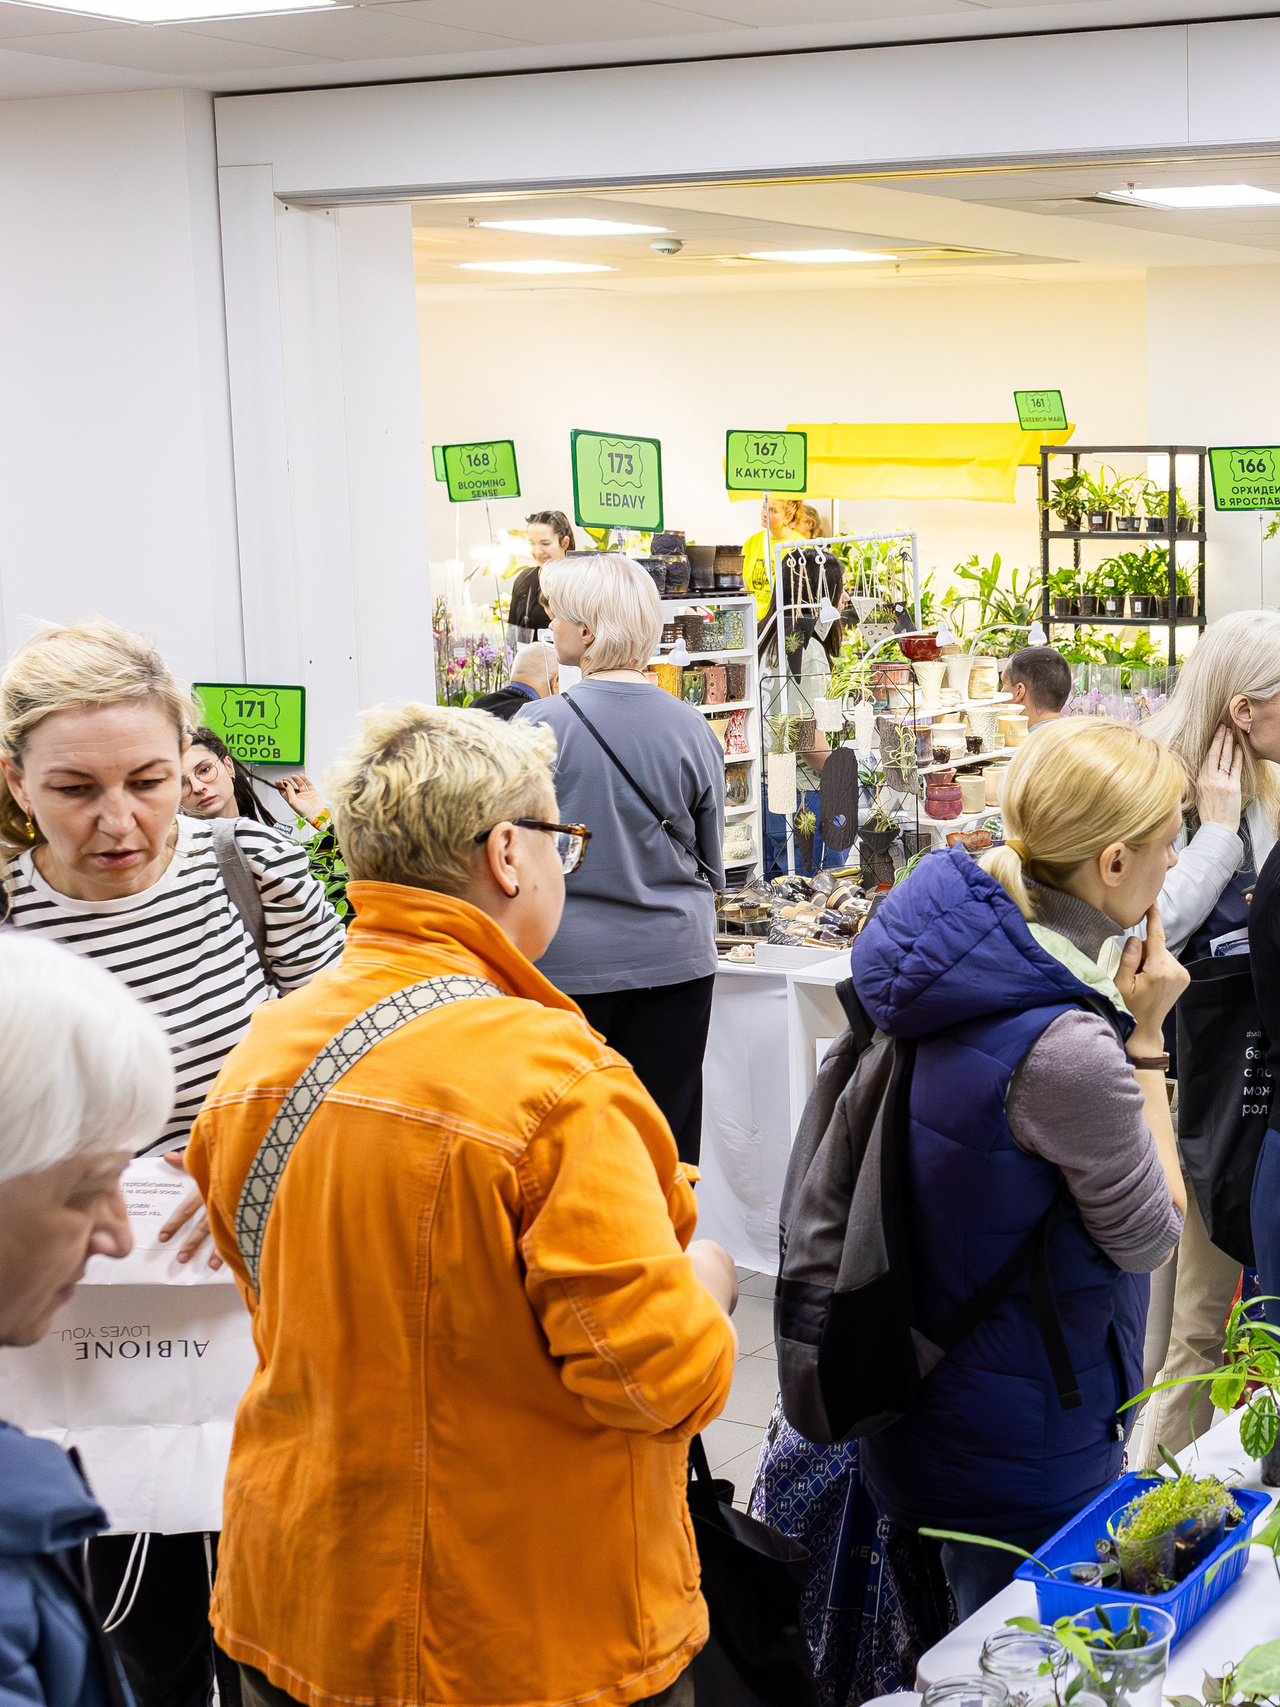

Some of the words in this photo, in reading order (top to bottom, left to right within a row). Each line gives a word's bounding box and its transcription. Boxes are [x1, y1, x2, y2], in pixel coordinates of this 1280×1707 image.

[1030, 398, 1045, 408] 161
[754, 442, 778, 456] 167
[466, 453, 490, 467] 168
[607, 452, 634, 475] 173
[1237, 458, 1266, 473] 166
[735, 467, 795, 480] КАКТУСЫ
[458, 478, 506, 490] BLOOMING
[471, 488, 499, 498] SENSE
[599, 491, 645, 509] LEDAVY
[1219, 498, 1226, 506] В
[235, 700, 265, 718] 171
[225, 733, 276, 746] ИГОРЬ
[228, 747, 281, 759] ГОРОВ
[1243, 1068, 1252, 1078] с
[100, 1325, 151, 1338] LOVES
[75, 1339, 210, 1361] ALBIONE
